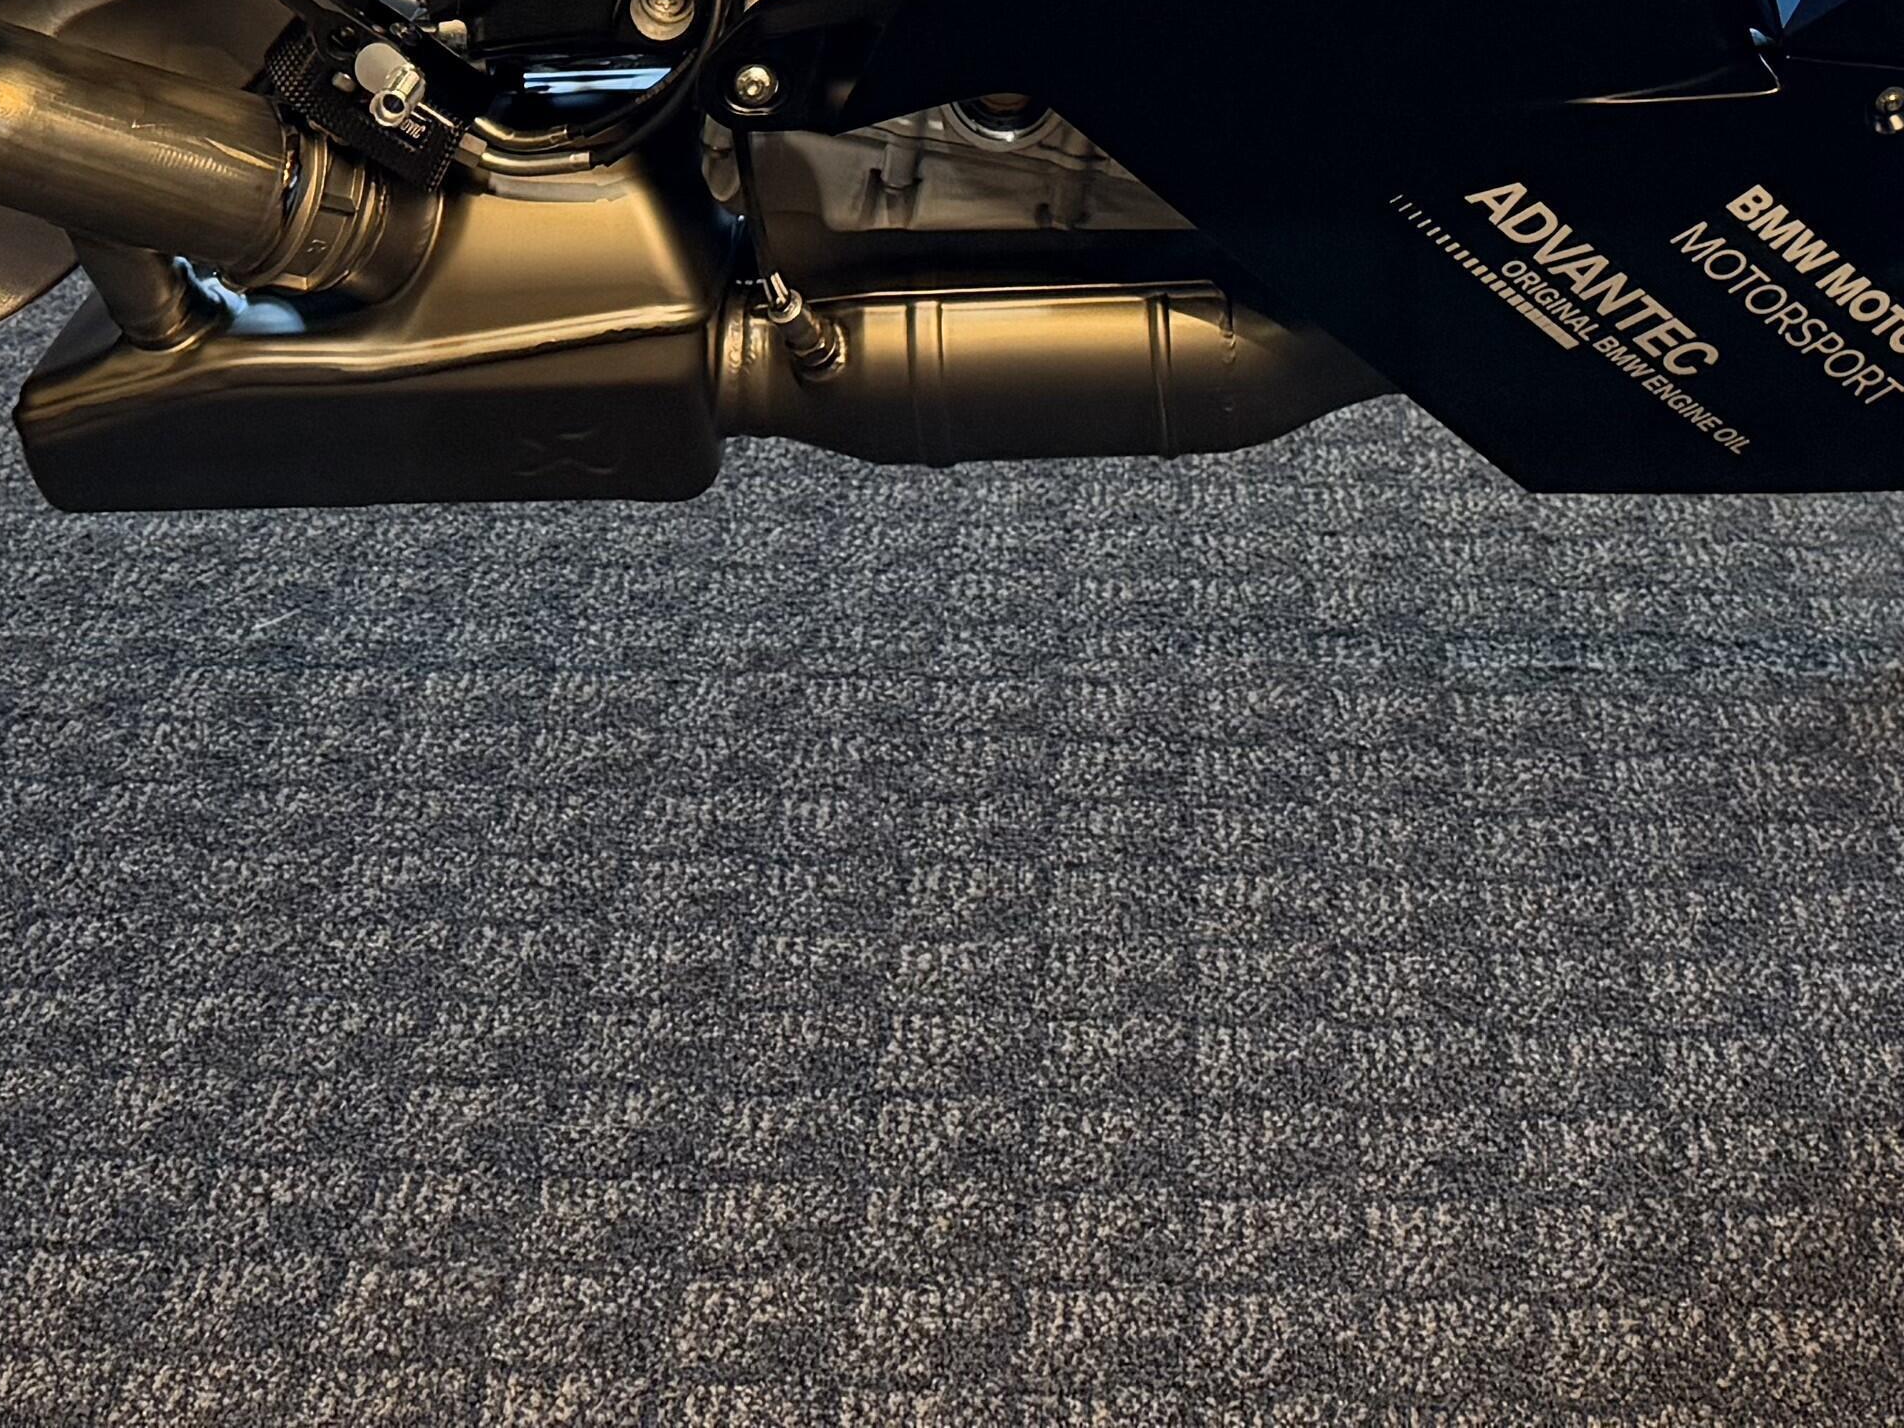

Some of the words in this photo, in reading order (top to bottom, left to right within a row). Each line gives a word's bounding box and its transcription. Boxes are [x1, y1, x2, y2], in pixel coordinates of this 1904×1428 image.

[1464, 182, 1720, 376] ADVANTEC
[1725, 184, 1840, 275] BMW
[1500, 259, 1601, 341] ORIGINAL
[1592, 334, 1655, 379] BMW
[1641, 374, 1724, 433] ENGINE
[1712, 426, 1751, 455] OIL
